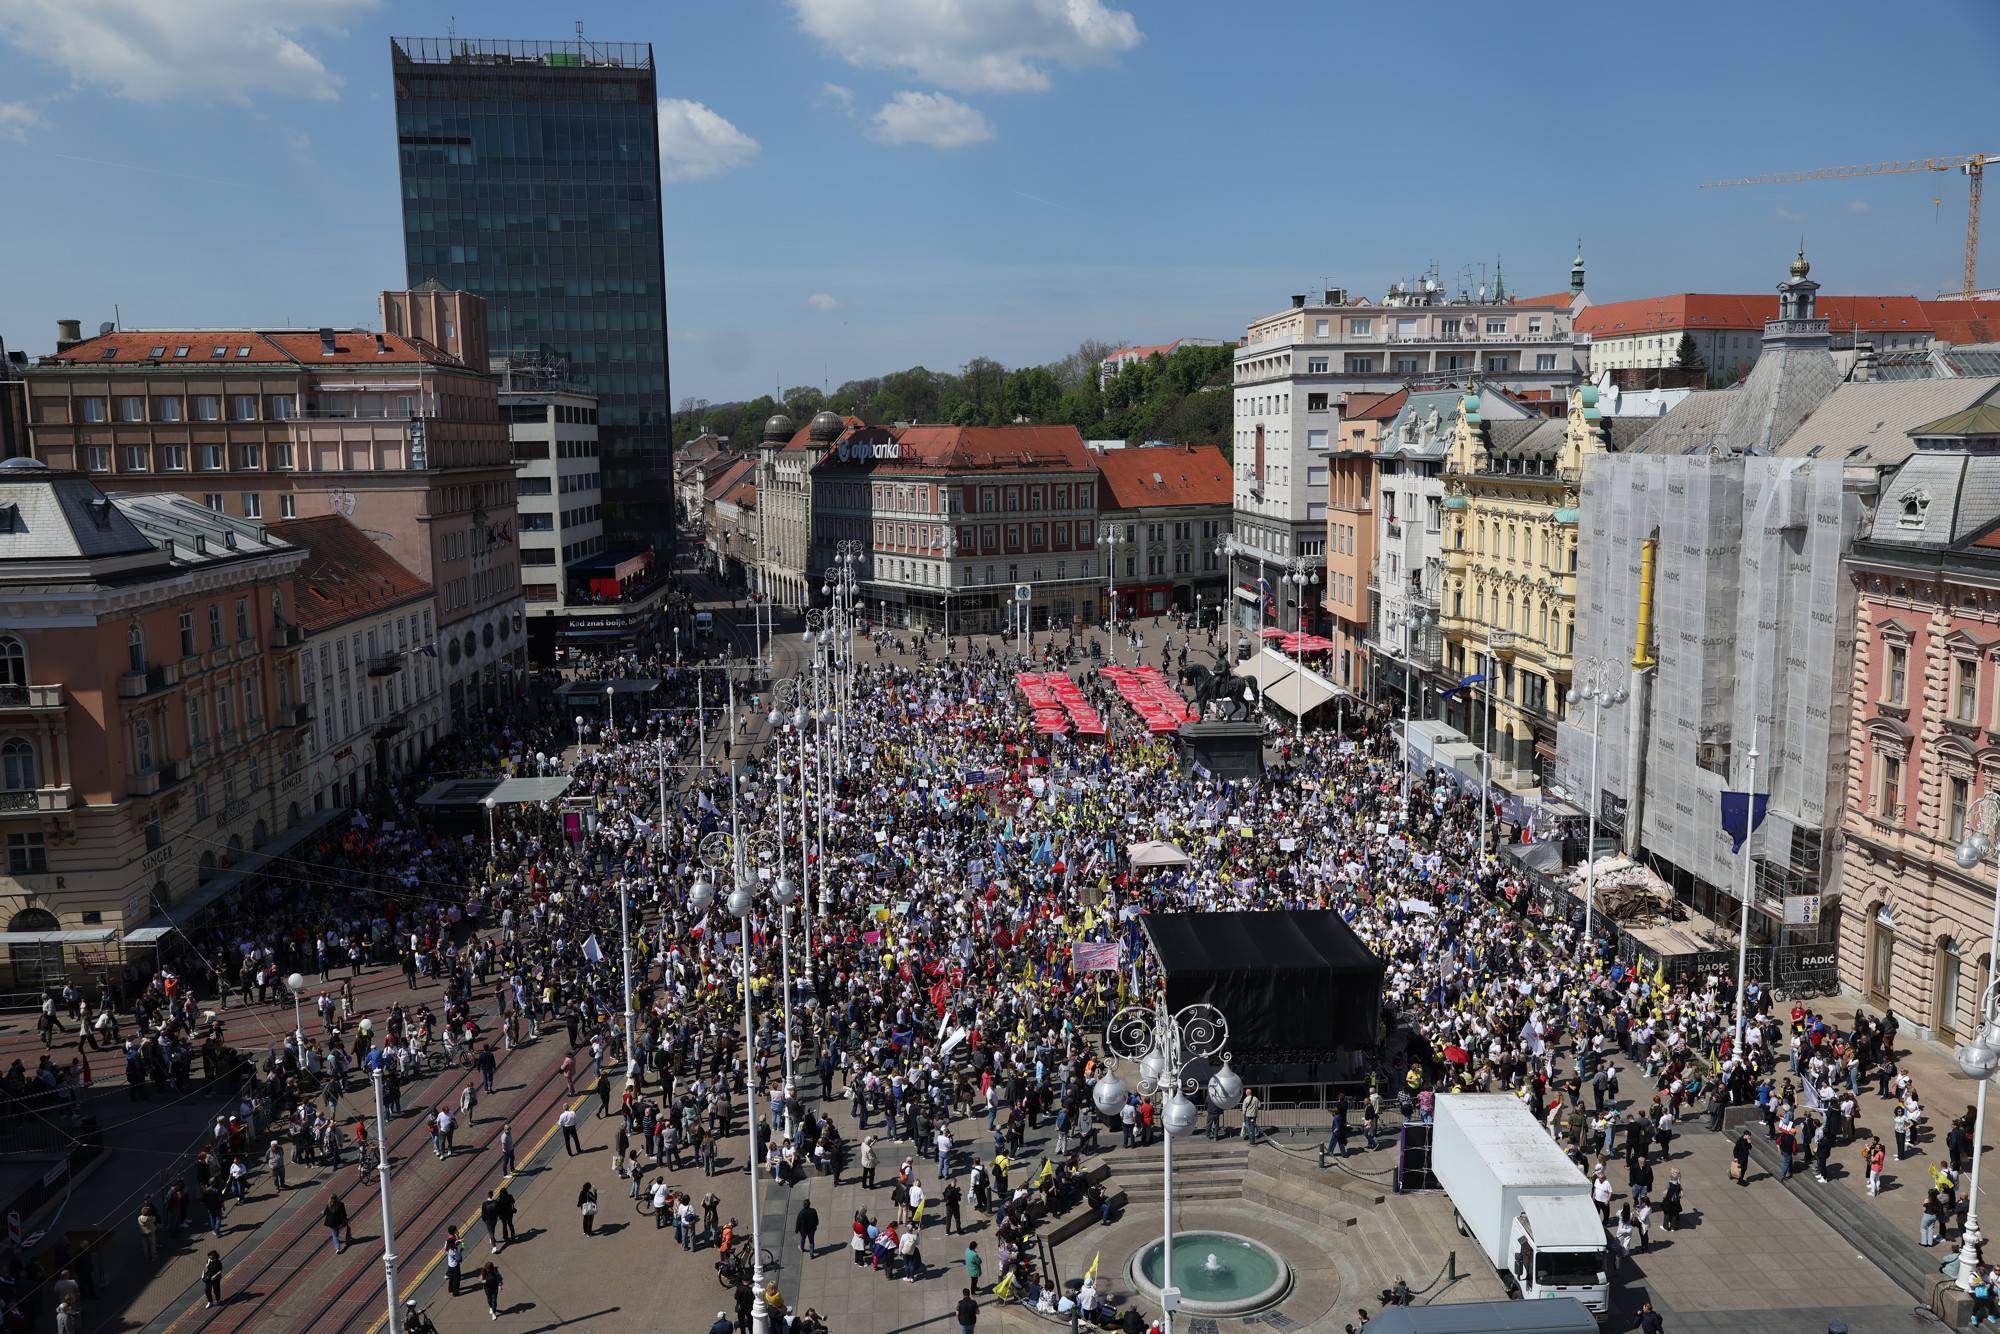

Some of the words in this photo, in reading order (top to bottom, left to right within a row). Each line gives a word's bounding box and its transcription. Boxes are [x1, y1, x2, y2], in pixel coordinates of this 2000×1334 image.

[851, 437, 899, 464] otpbanka
[1632, 482, 1646, 492] RADIĆ
[1668, 484, 1684, 495] RADIĆ
[1818, 514, 1838, 525] RADIĆ
[1684, 546, 1700, 557] RADIĆ
[1704, 546, 1737, 556] RADIĆ
[1791, 563, 1812, 573] RADIĆ
[1664, 570, 1680, 581] RADIĆ
[586, 619, 605, 627] znaš
[1812, 611, 1832, 624] RADIĆ
[1758, 620, 1779, 630] RADIĆ
[1681, 632, 1698, 644] RADIĆ
[1702, 636, 1736, 648] RADIĆ
[1786, 658, 1807, 670] RADIĆ
[1806, 706, 1827, 720] RADIĆ
[1678, 718, 1694, 730] RADIĆ
[1781, 750, 1802, 764] RADIĆ
[282, 773, 302, 792] SINGER
[1696, 787, 1714, 803] RADIĆ
[1676, 803, 1693, 816] RADIĆ
[1658, 820, 1672, 833] RADIĆ
[142, 845, 173, 872] SINGER
[1076, 958, 1118, 970] ZADAR
[1802, 954, 1834, 965] RADIĆ
